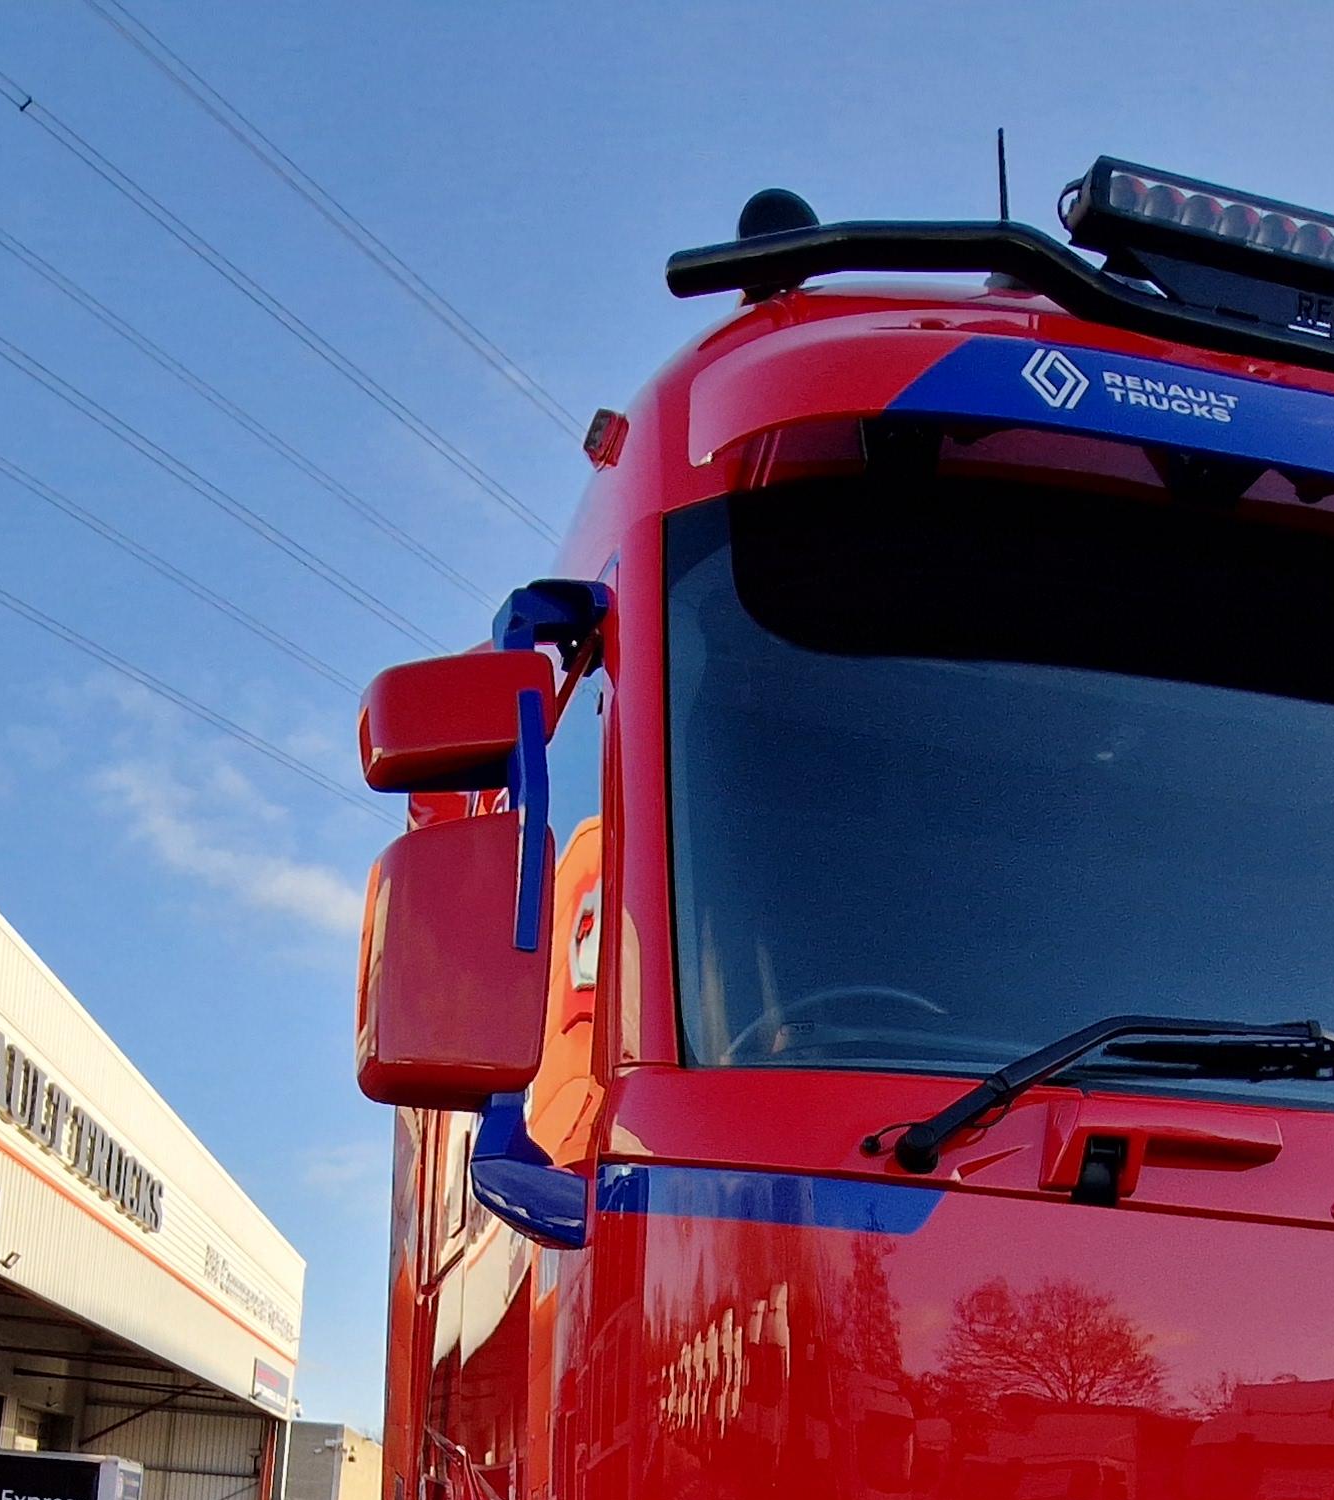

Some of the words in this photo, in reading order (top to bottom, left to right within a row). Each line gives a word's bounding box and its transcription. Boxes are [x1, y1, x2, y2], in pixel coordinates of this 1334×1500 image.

[1102, 370, 1238, 409] RENAULT
[1106, 386, 1233, 423] TRUCKS
[72, 1105, 164, 1234] TRUCKS
